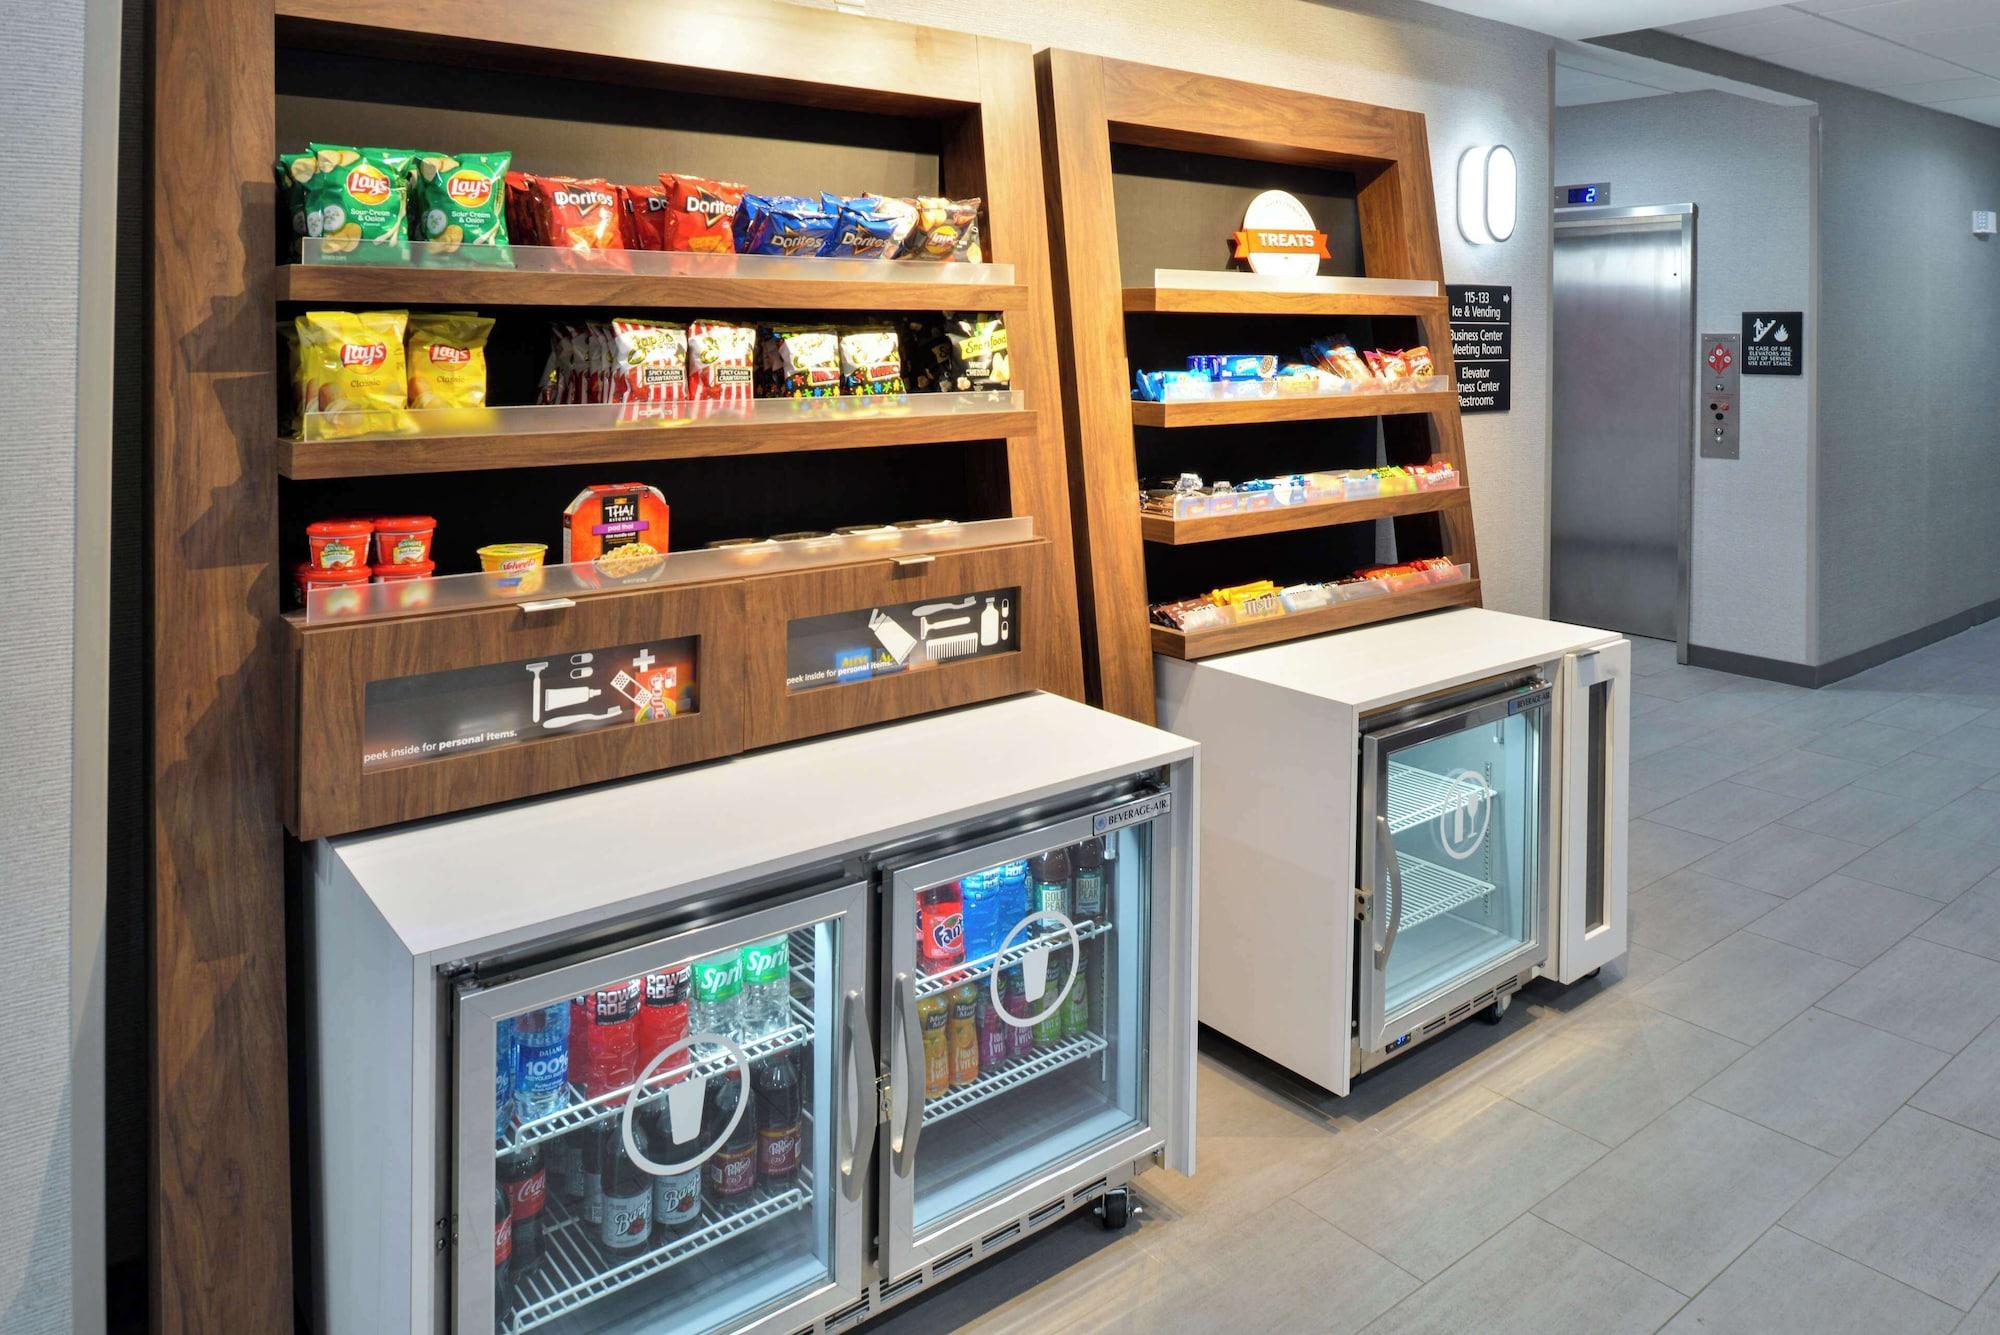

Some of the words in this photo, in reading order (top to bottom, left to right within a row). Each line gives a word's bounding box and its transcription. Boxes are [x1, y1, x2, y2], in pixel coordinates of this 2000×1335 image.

[351, 173, 389, 197] Lay's
[451, 178, 490, 199] Lay's
[554, 191, 614, 207] Doritos
[1586, 188, 1596, 202] 2
[771, 235, 824, 249] Doritos
[842, 232, 889, 248] Doritos
[1258, 232, 1315, 247] TREATS
[1464, 291, 1490, 304] 115-133
[1452, 305, 1462, 317] Ice
[1464, 305, 1470, 317] &
[1472, 306, 1501, 320] Vending
[1480, 329, 1503, 341] Center
[344, 343, 384, 366] Lay's
[432, 345, 469, 363] Lay's
[1481, 344, 1502, 355] Room
[1462, 366, 1490, 379] Elevator
[350, 379, 380, 388] Classic
[1477, 380, 1500, 392] Center
[605, 505, 634, 517] THAI
[607, 523, 621, 533] pad
[786, 675, 804, 686] peek
[805, 670, 825, 682] inside
[826, 669, 837, 678] for
[838, 663, 869, 677] personal
[363, 750, 388, 764] peek
[391, 743, 420, 758] inside
[422, 742, 437, 753] for
[439, 733, 484, 751] personal
[486, 730, 518, 742] items.
[1109, 799, 1167, 825] BEVERAGE-AIR
[1045, 891, 1065, 901] GOLD
[1045, 901, 1064, 912] PEAK
[647, 985, 674, 999] ADE
[597, 1001, 626, 1016] ADE
[525, 1051, 569, 1076] 100%
